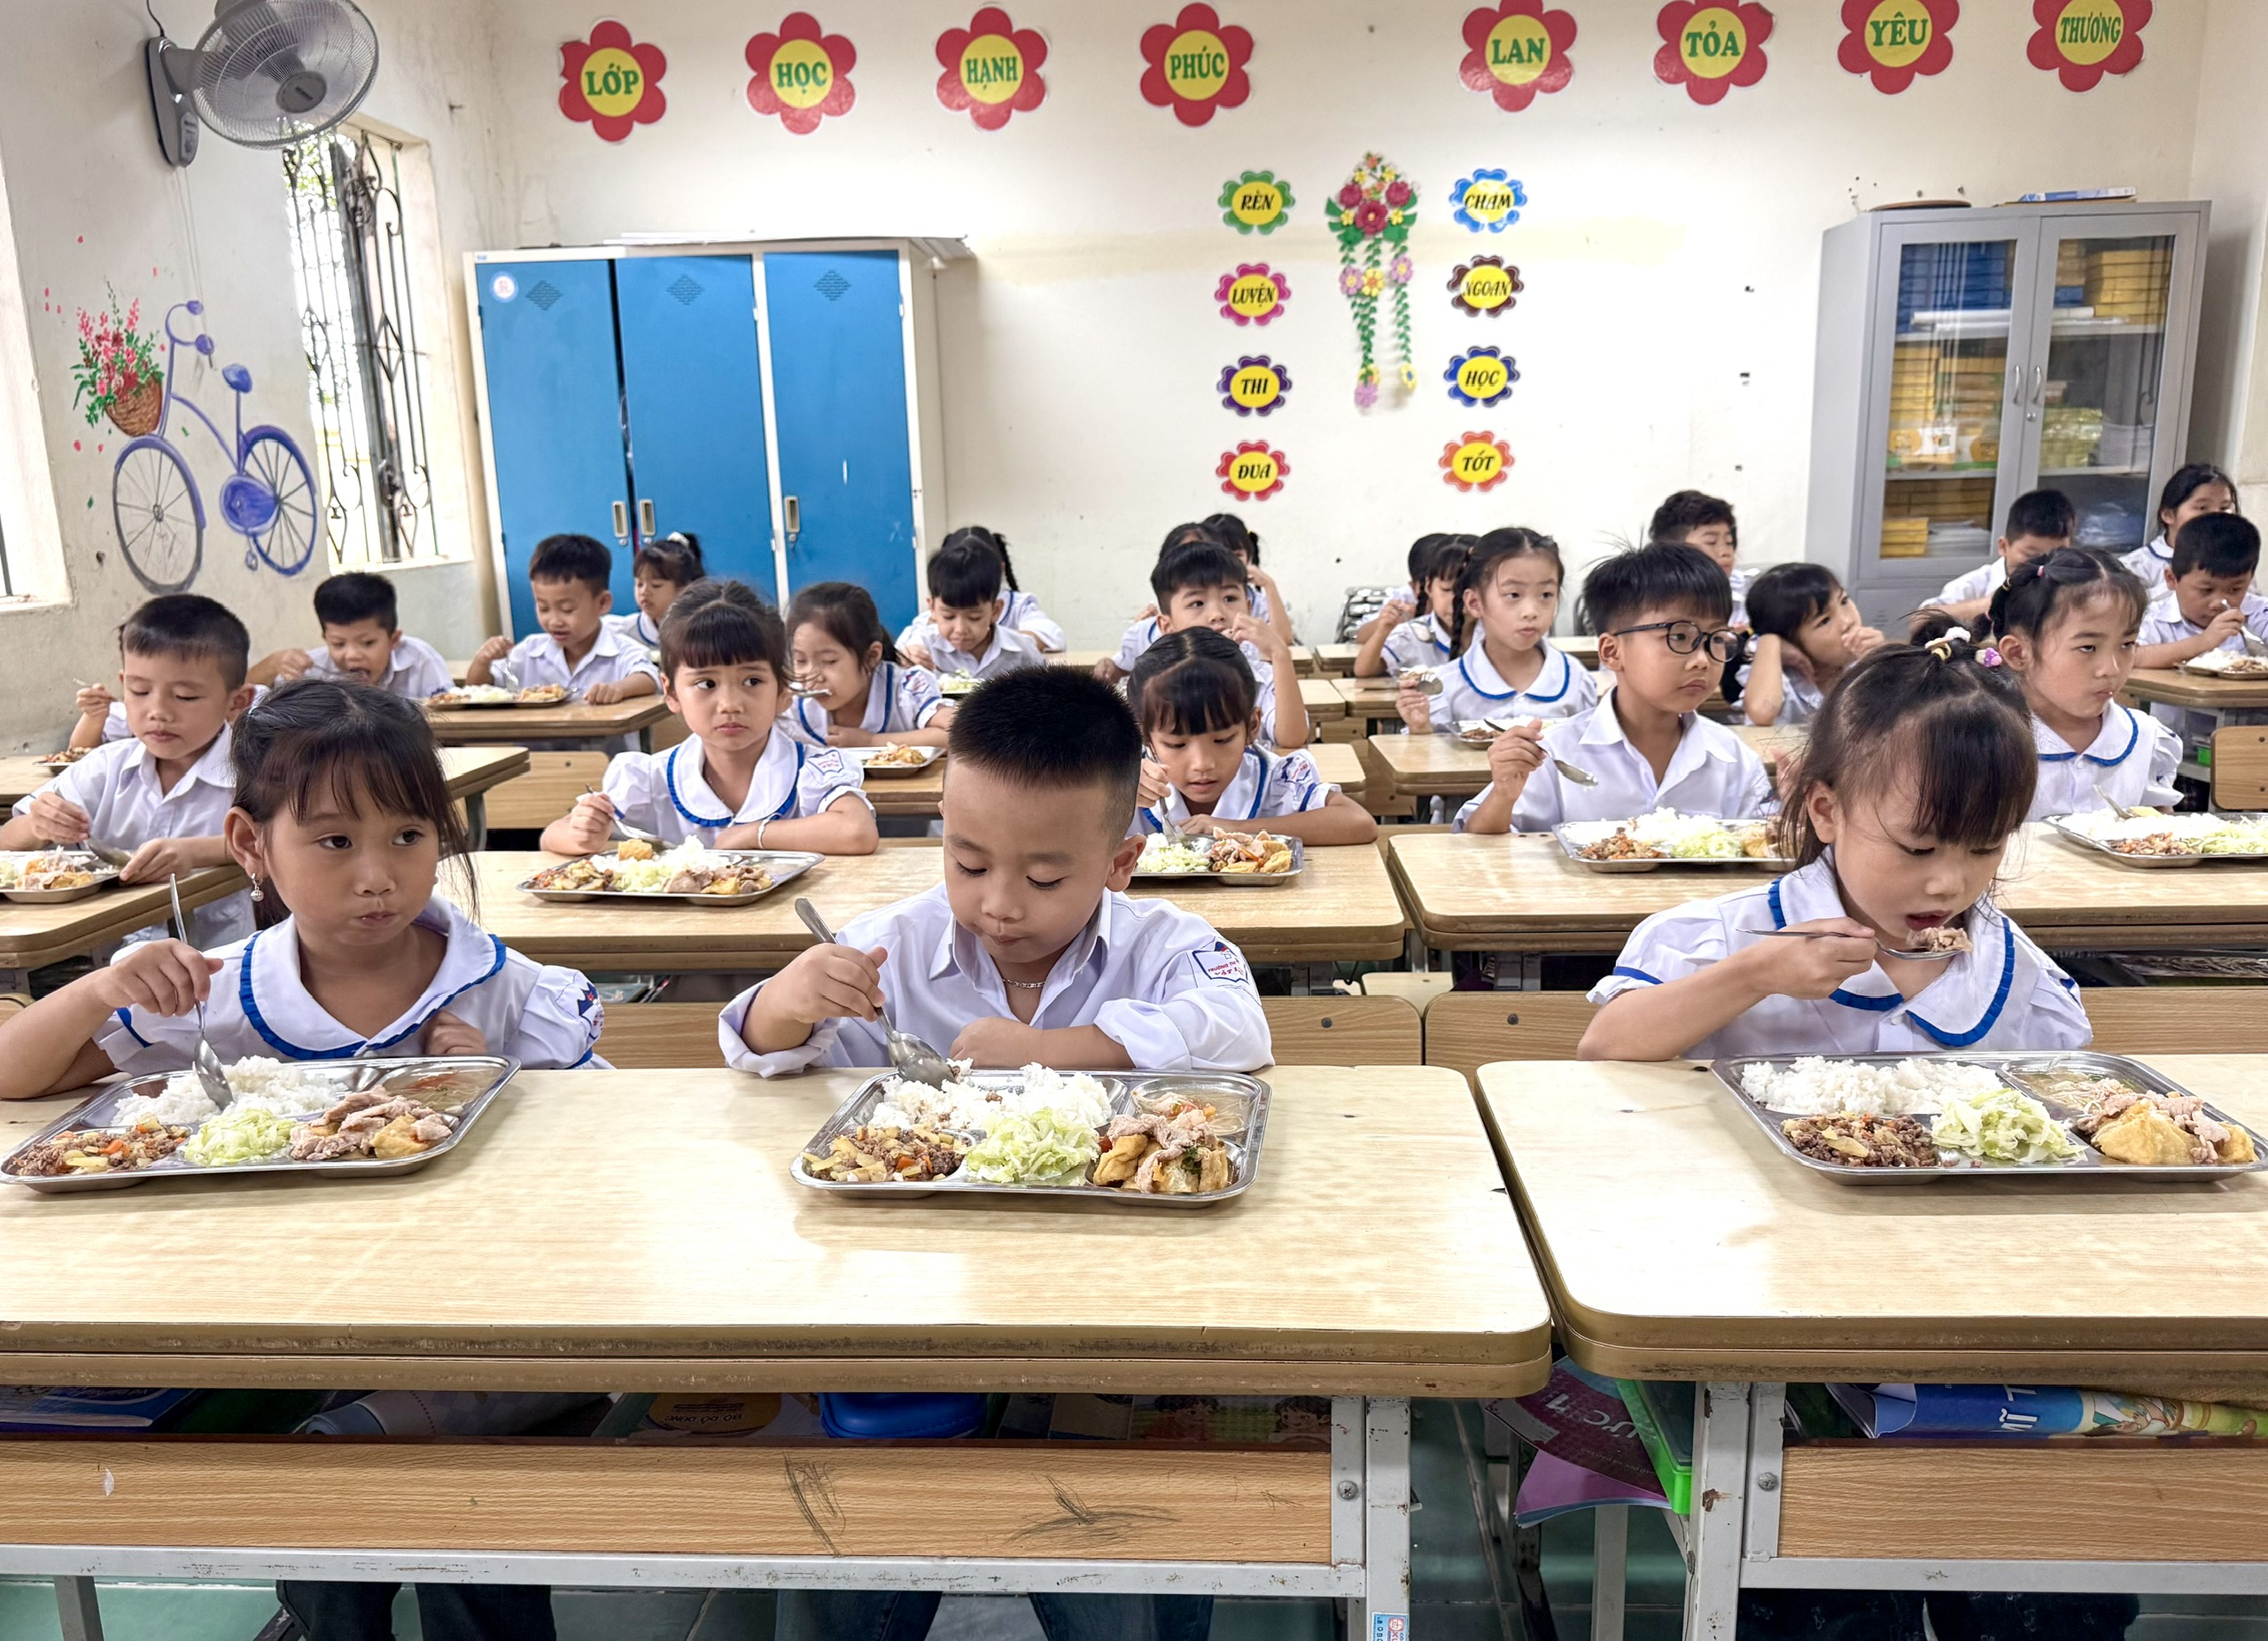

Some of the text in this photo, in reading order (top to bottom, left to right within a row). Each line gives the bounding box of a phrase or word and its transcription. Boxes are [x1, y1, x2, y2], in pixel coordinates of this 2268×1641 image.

[585, 11, 2121, 97] LỚP HỌC HẠNH PHÚC LAN TỎA YÊU THƯƠNG
[1240, 190, 1274, 211] RÈN
[1231, 283, 1276, 307] LUYỆN
[1462, 279, 1511, 297] NGOAN
[1240, 377, 1269, 395] THI
[1465, 369, 1501, 391] HỌC
[1238, 463, 1271, 479] ĐUA
[1463, 450, 1495, 471] TỐT
[1583, 1409, 1638, 1439] ỨC
